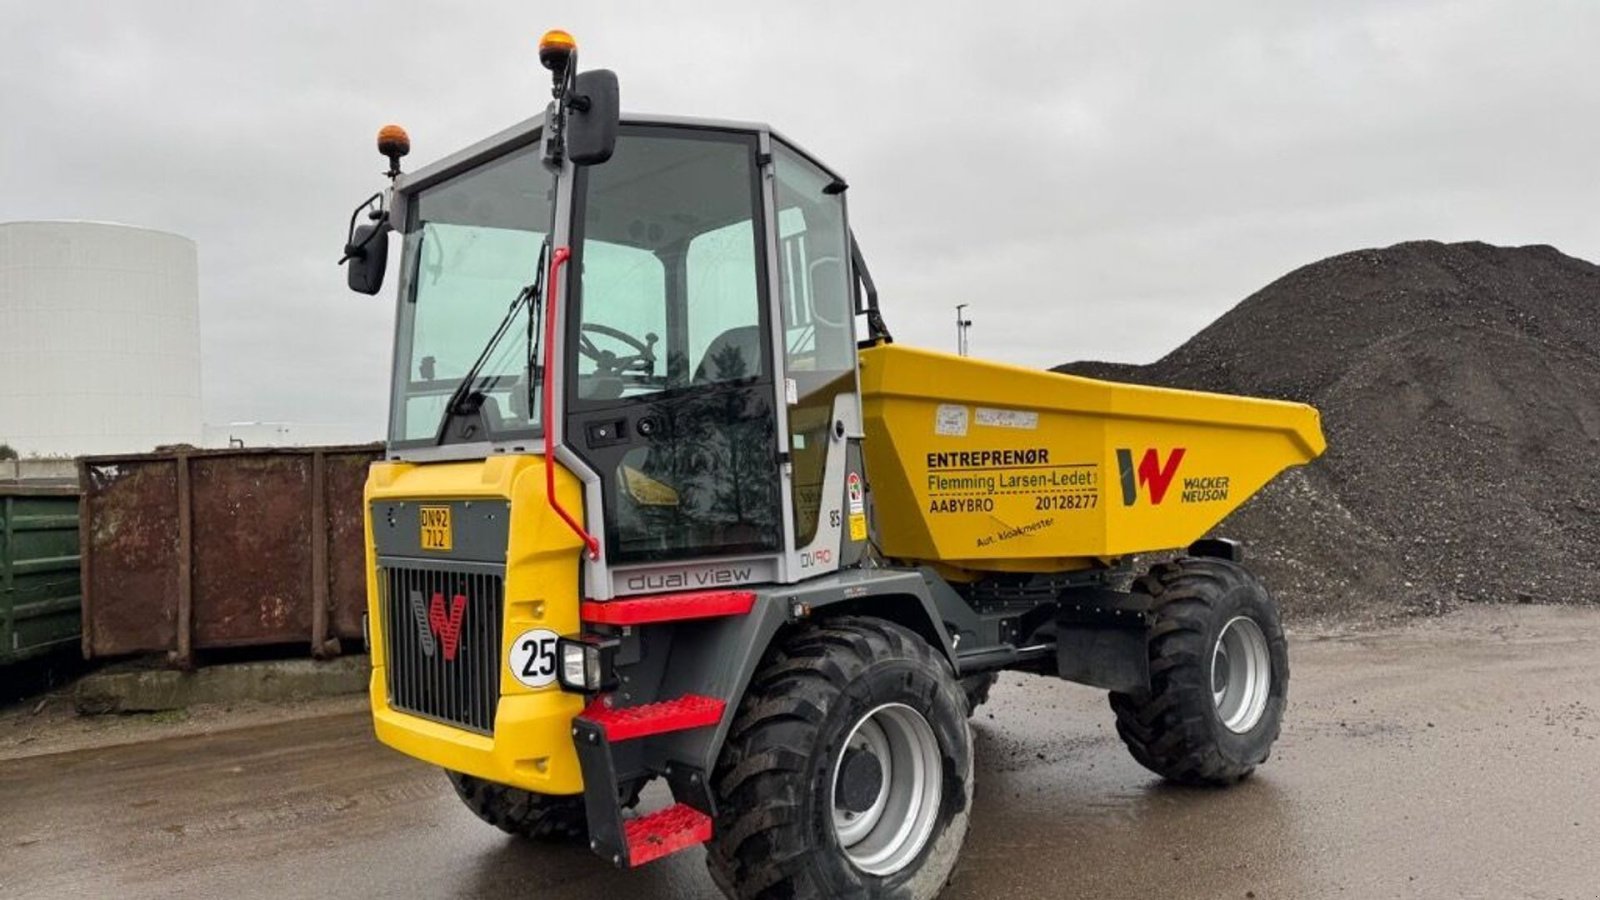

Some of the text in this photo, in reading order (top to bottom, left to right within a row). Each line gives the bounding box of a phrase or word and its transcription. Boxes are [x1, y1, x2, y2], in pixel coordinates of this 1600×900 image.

[926, 448, 1049, 468] ENTREPRENØR
[928, 474, 995, 492] Flemming
[999, 470, 1091, 488] Larsen-Ledet
[1183, 476, 1230, 489] WACKER
[929, 494, 1098, 514] AABYBRO 20128277
[1181, 489, 1228, 503] NEUSON
[421, 509, 448, 527] DN92
[997, 517, 1054, 541] kloakmester
[627, 567, 752, 590] dual view
[521, 638, 555, 678] 25
